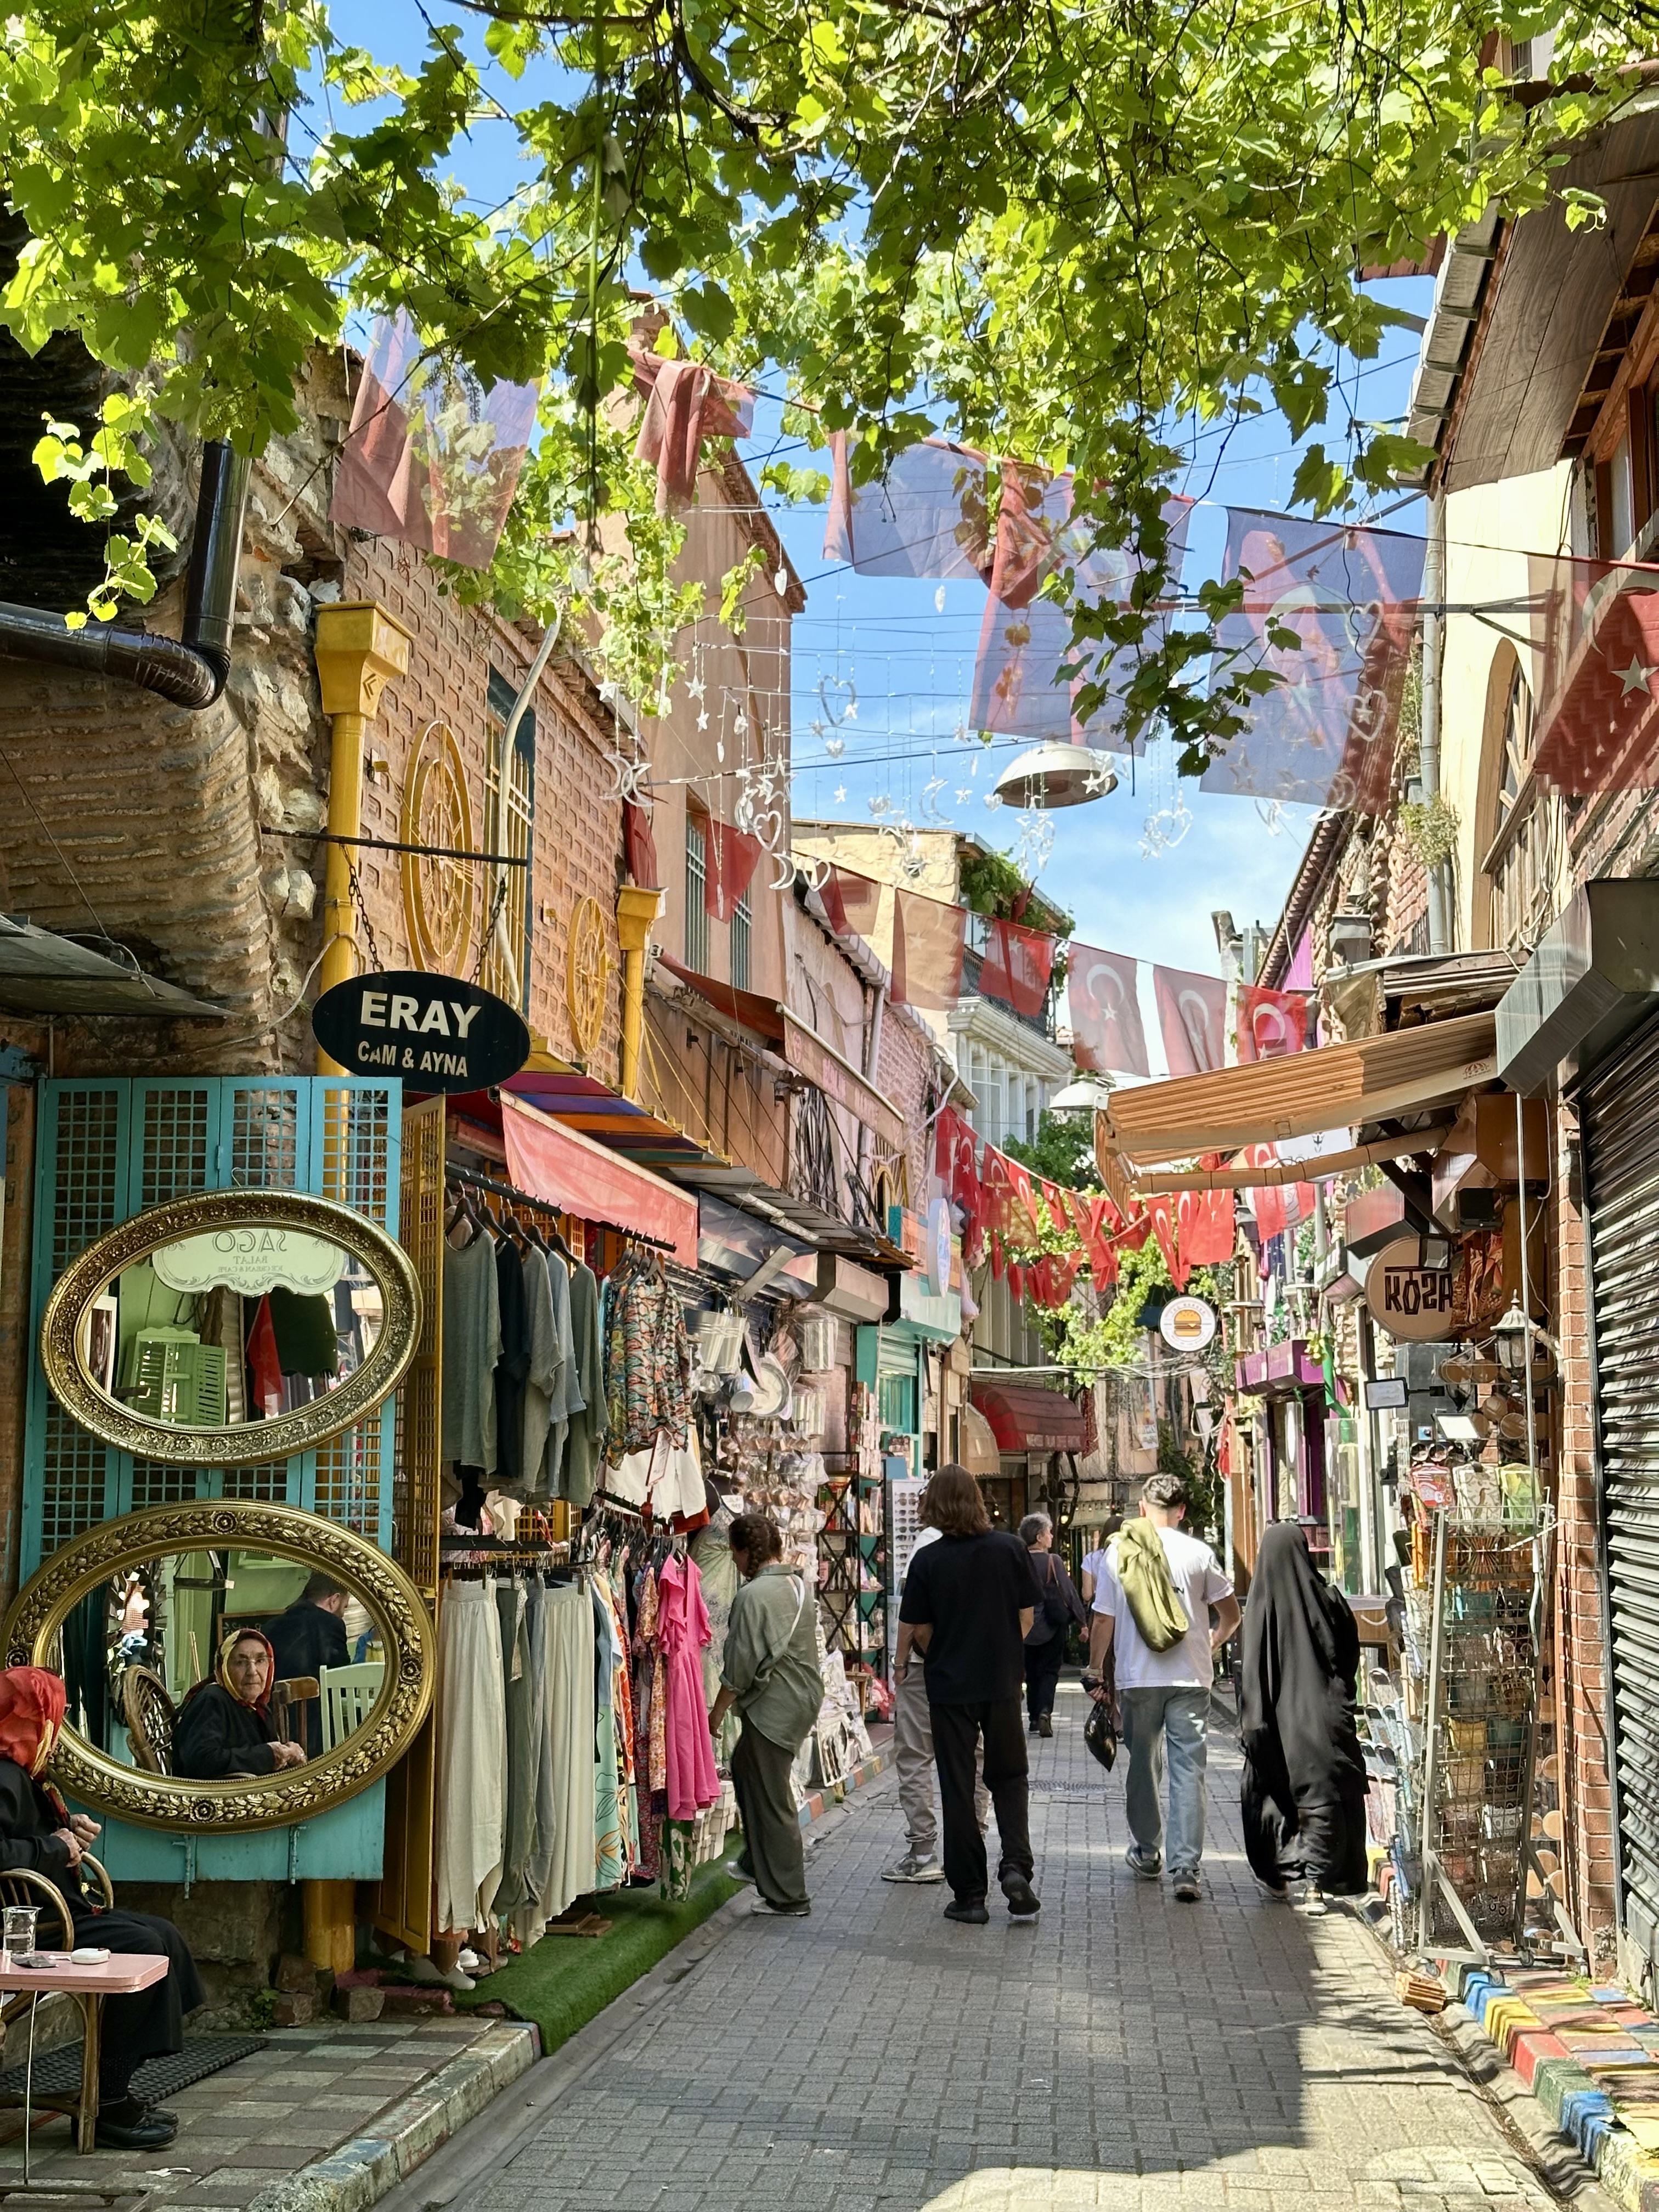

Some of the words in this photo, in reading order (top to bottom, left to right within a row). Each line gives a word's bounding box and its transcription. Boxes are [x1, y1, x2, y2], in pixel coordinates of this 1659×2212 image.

[360, 991, 482, 1039] ERAY
[358, 1041, 397, 1066] CAM
[402, 1048, 414, 1069] &
[420, 1051, 468, 1077] AYNA
